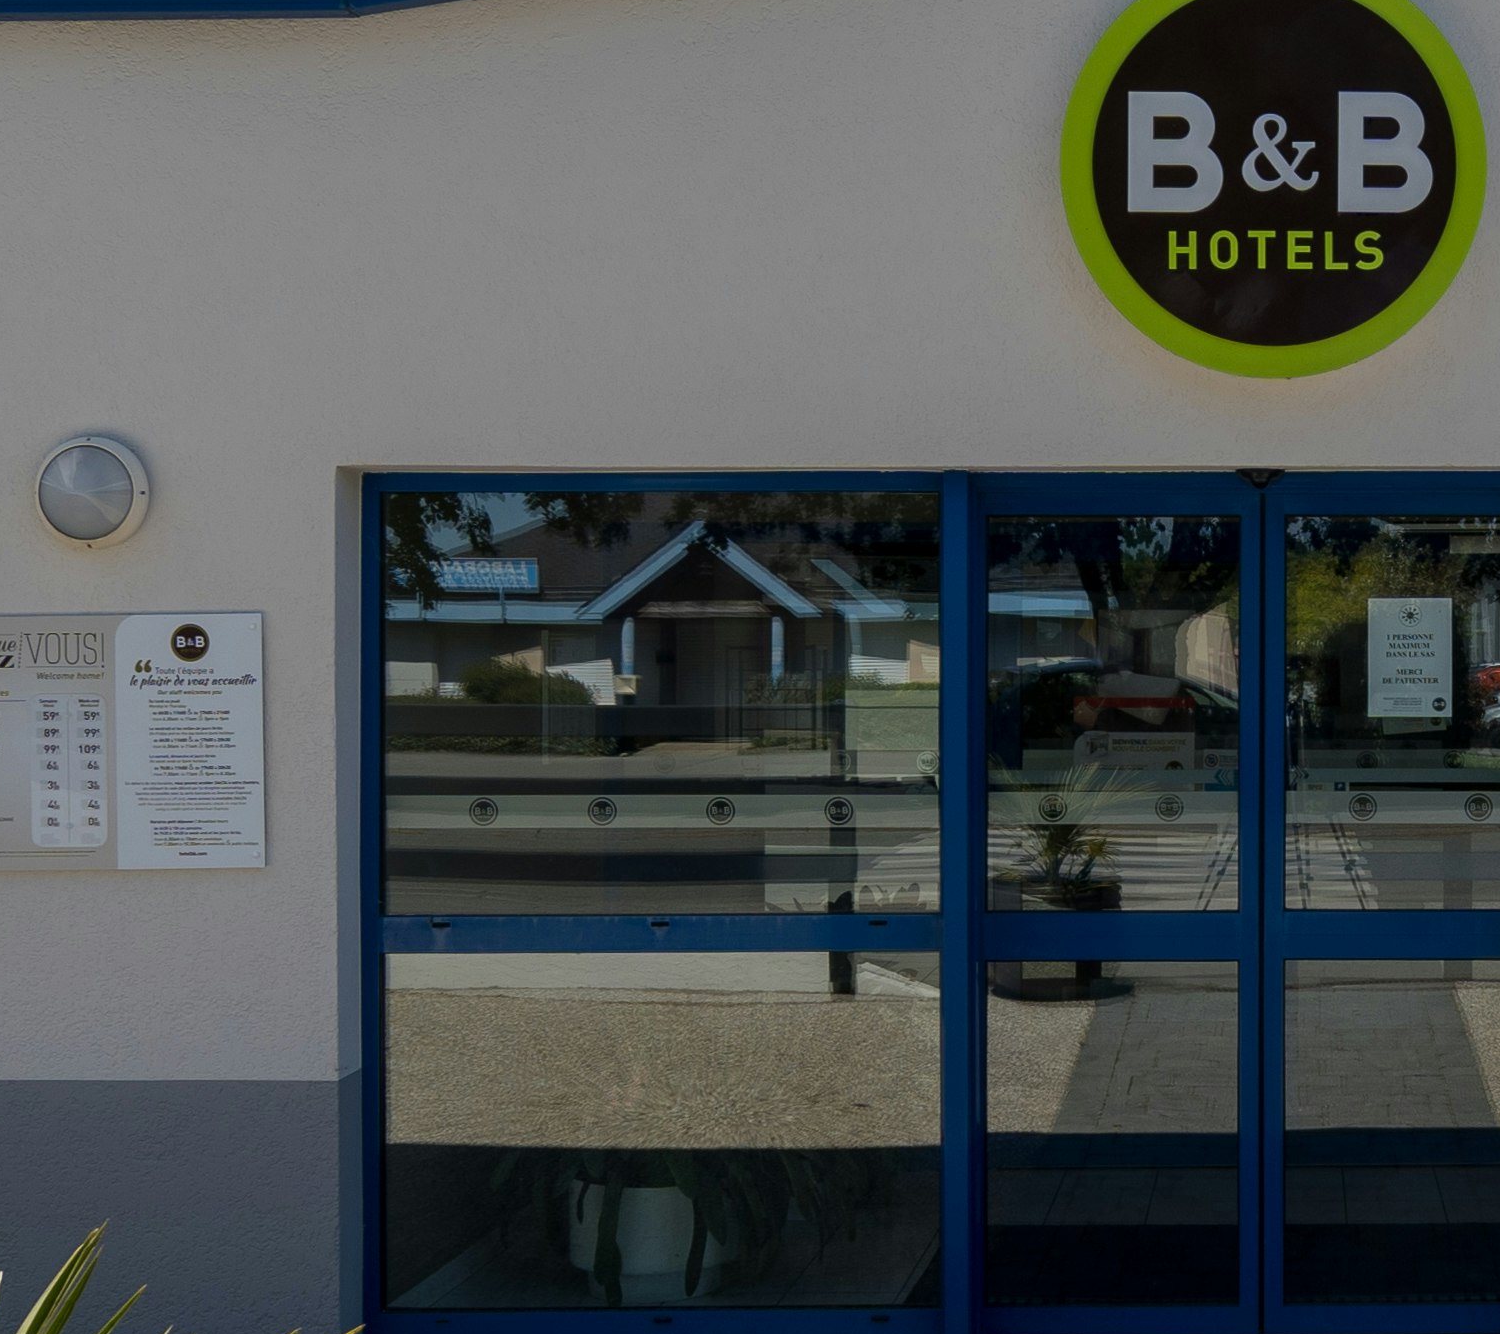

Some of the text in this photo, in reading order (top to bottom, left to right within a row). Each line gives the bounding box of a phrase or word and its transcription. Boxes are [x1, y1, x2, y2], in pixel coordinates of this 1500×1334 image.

[1128, 91, 1433, 213] B&B
[1168, 230, 1384, 270] HOTELS
[36, 672, 75, 680] Welcome
[130, 675, 138, 686] le
[140, 675, 172, 690] plaisir
[174, 675, 184, 686] de
[188, 678, 208, 686] vous
